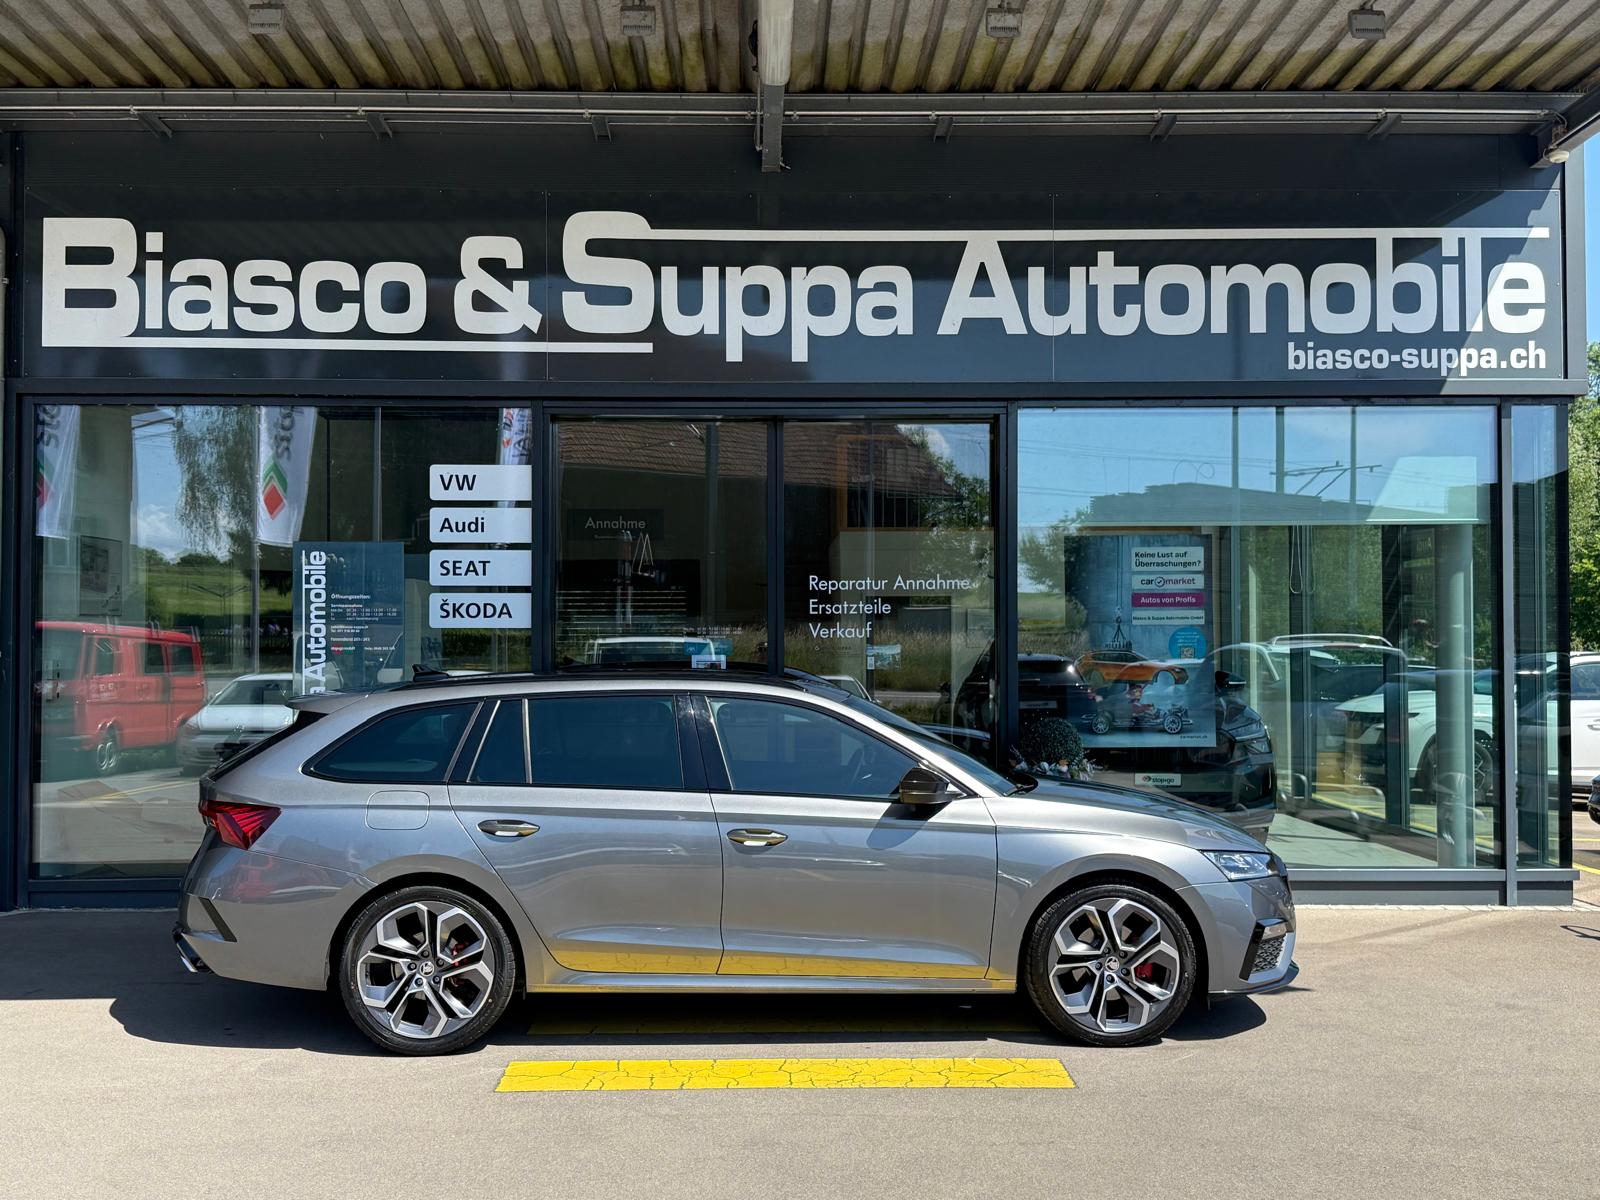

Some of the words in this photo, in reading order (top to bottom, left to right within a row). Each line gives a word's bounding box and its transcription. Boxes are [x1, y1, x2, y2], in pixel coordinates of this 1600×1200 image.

[42, 217, 427, 348] Biasco
[453, 236, 542, 335] &
[562, 211, 913, 362] Suppa
[937, 228, 1546, 335] Automobile
[1287, 341, 1547, 377] biasco-suppa.ch
[439, 474, 477, 491] VW
[439, 516, 485, 533] Audi
[584, 515, 647, 530] Annahme
[439, 560, 491, 577] SEAT
[1135, 559, 1202, 568] Überraschungen?
[809, 575, 888, 594] Reparatur
[893, 574, 971, 591] Annahme
[439, 598, 513, 619] ŠKODA
[809, 598, 892, 615] Ersatzteile
[1140, 596, 1160, 604] Autos
[304, 550, 327, 681] Automobile
[809, 621, 873, 638] Verkauf
